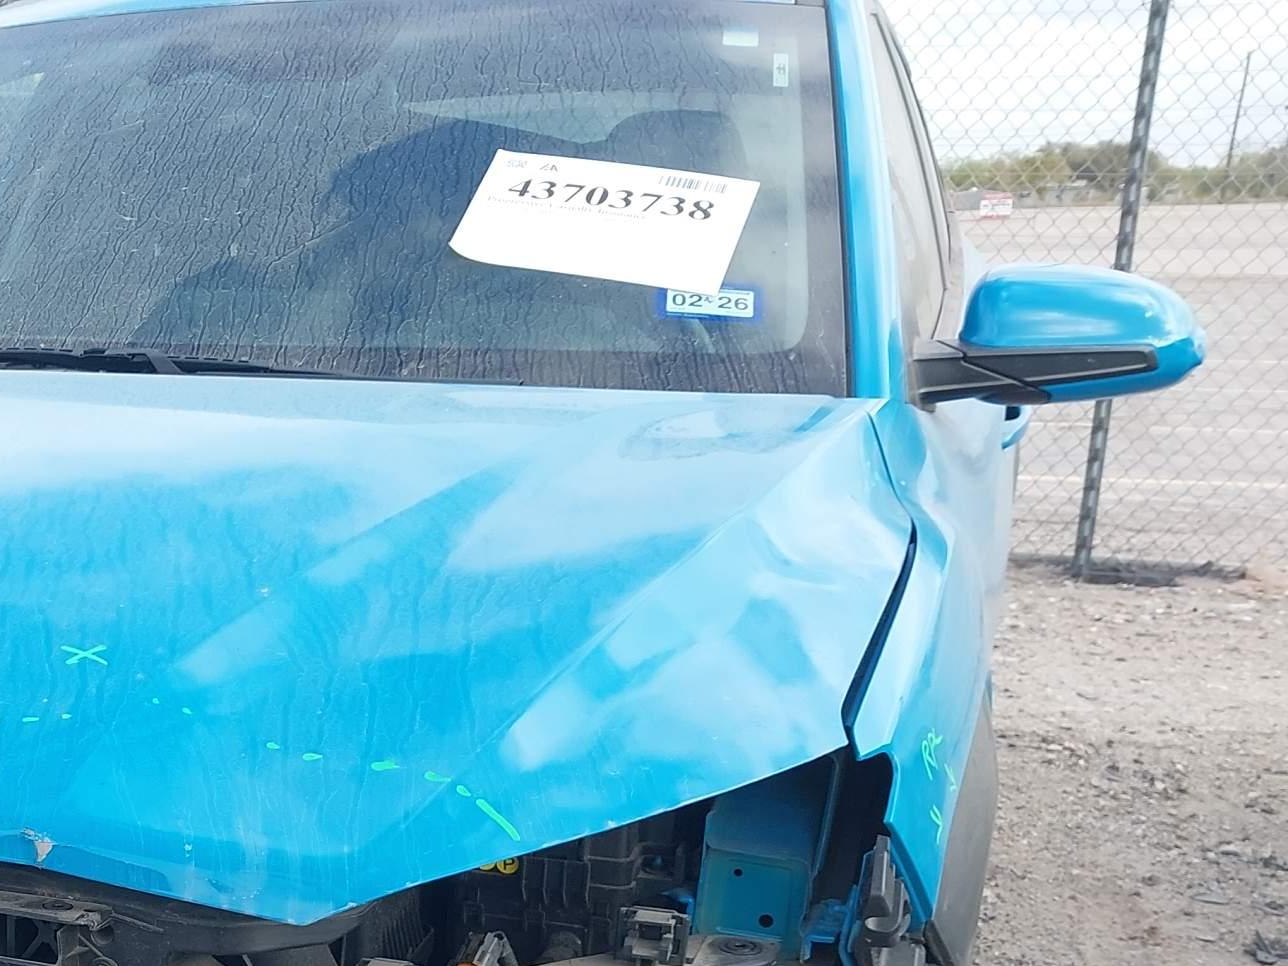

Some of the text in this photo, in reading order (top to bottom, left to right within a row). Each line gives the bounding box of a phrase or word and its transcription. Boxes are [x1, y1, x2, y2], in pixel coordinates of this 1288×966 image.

[508, 178, 715, 221] 43703738
[672, 293, 749, 311] 02 26
